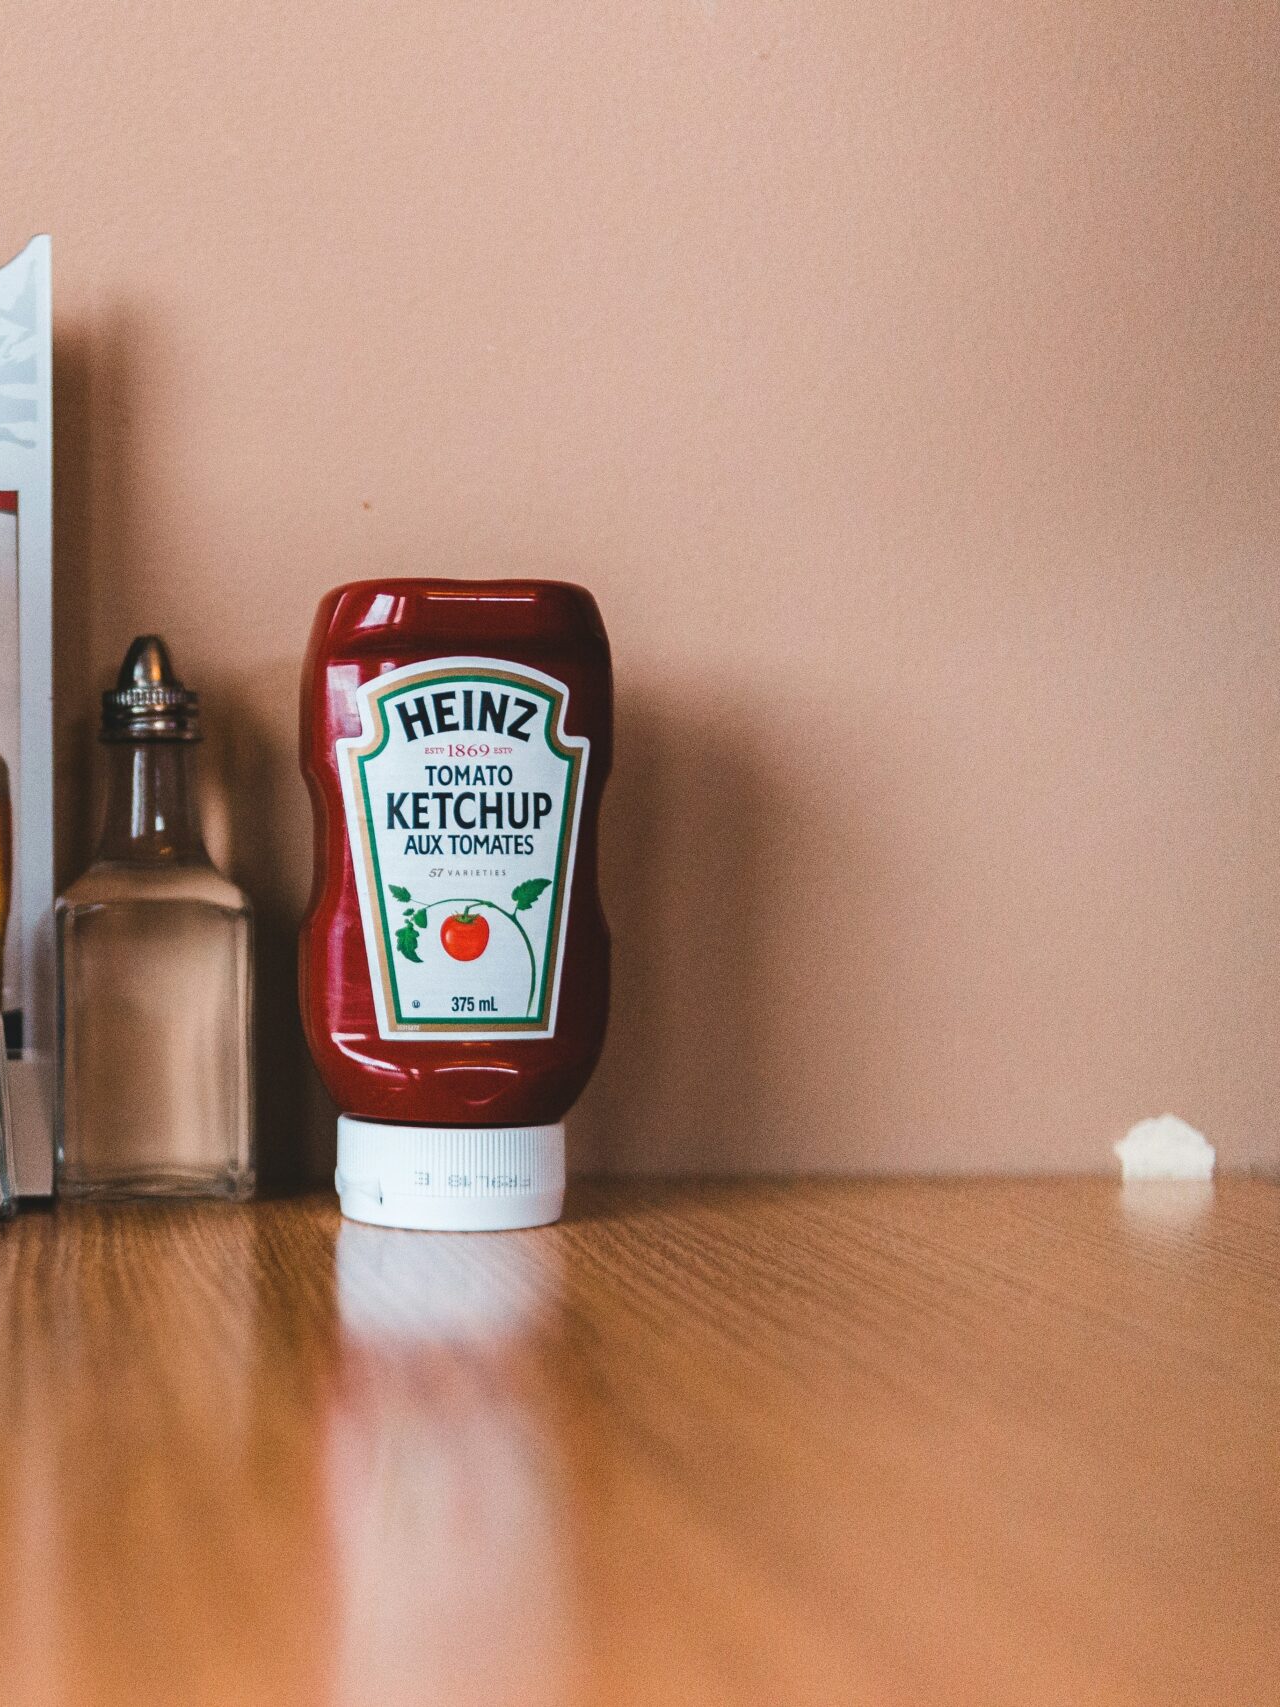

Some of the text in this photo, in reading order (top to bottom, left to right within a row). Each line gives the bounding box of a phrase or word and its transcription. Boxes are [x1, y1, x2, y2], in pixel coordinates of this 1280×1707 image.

[394, 690, 538, 742] HEINZ
[447, 744, 490, 757] 1869
[425, 765, 513, 786] TOMATO
[386, 791, 552, 830] KETCHUP
[404, 834, 534, 855] AUX TOMATES
[428, 868, 507, 877] 57 VARIETIES
[451, 996, 498, 1012] 375 mL
